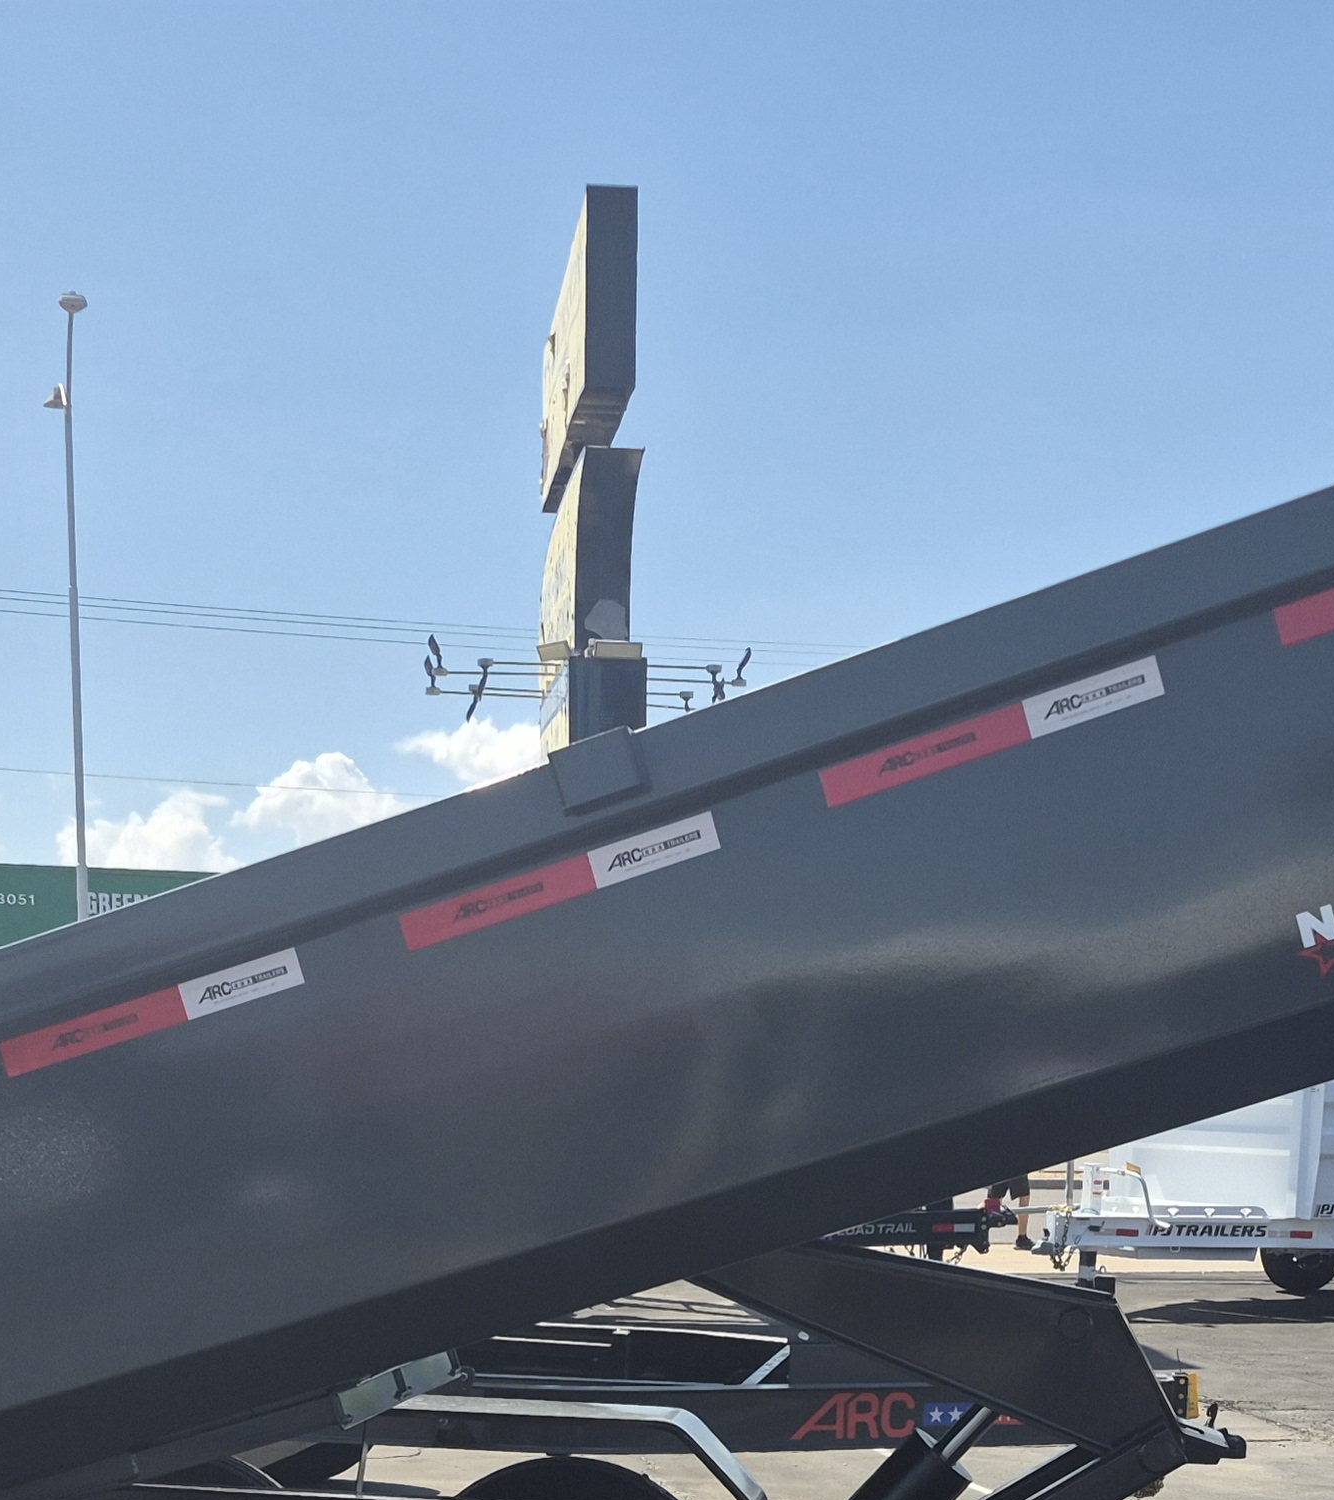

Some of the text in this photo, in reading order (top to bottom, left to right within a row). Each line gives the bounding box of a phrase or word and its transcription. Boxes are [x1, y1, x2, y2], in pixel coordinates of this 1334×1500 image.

[1045, 694, 1082, 719] ARC
[608, 848, 642, 872] ARC
[198, 982, 232, 1004] ARC
[1320, 1204, 1334, 1215] PJ
[876, 1223, 916, 1234] TRAIL
[1175, 1225, 1267, 1237] TRAILERS
[789, 1392, 916, 1440] ARC
